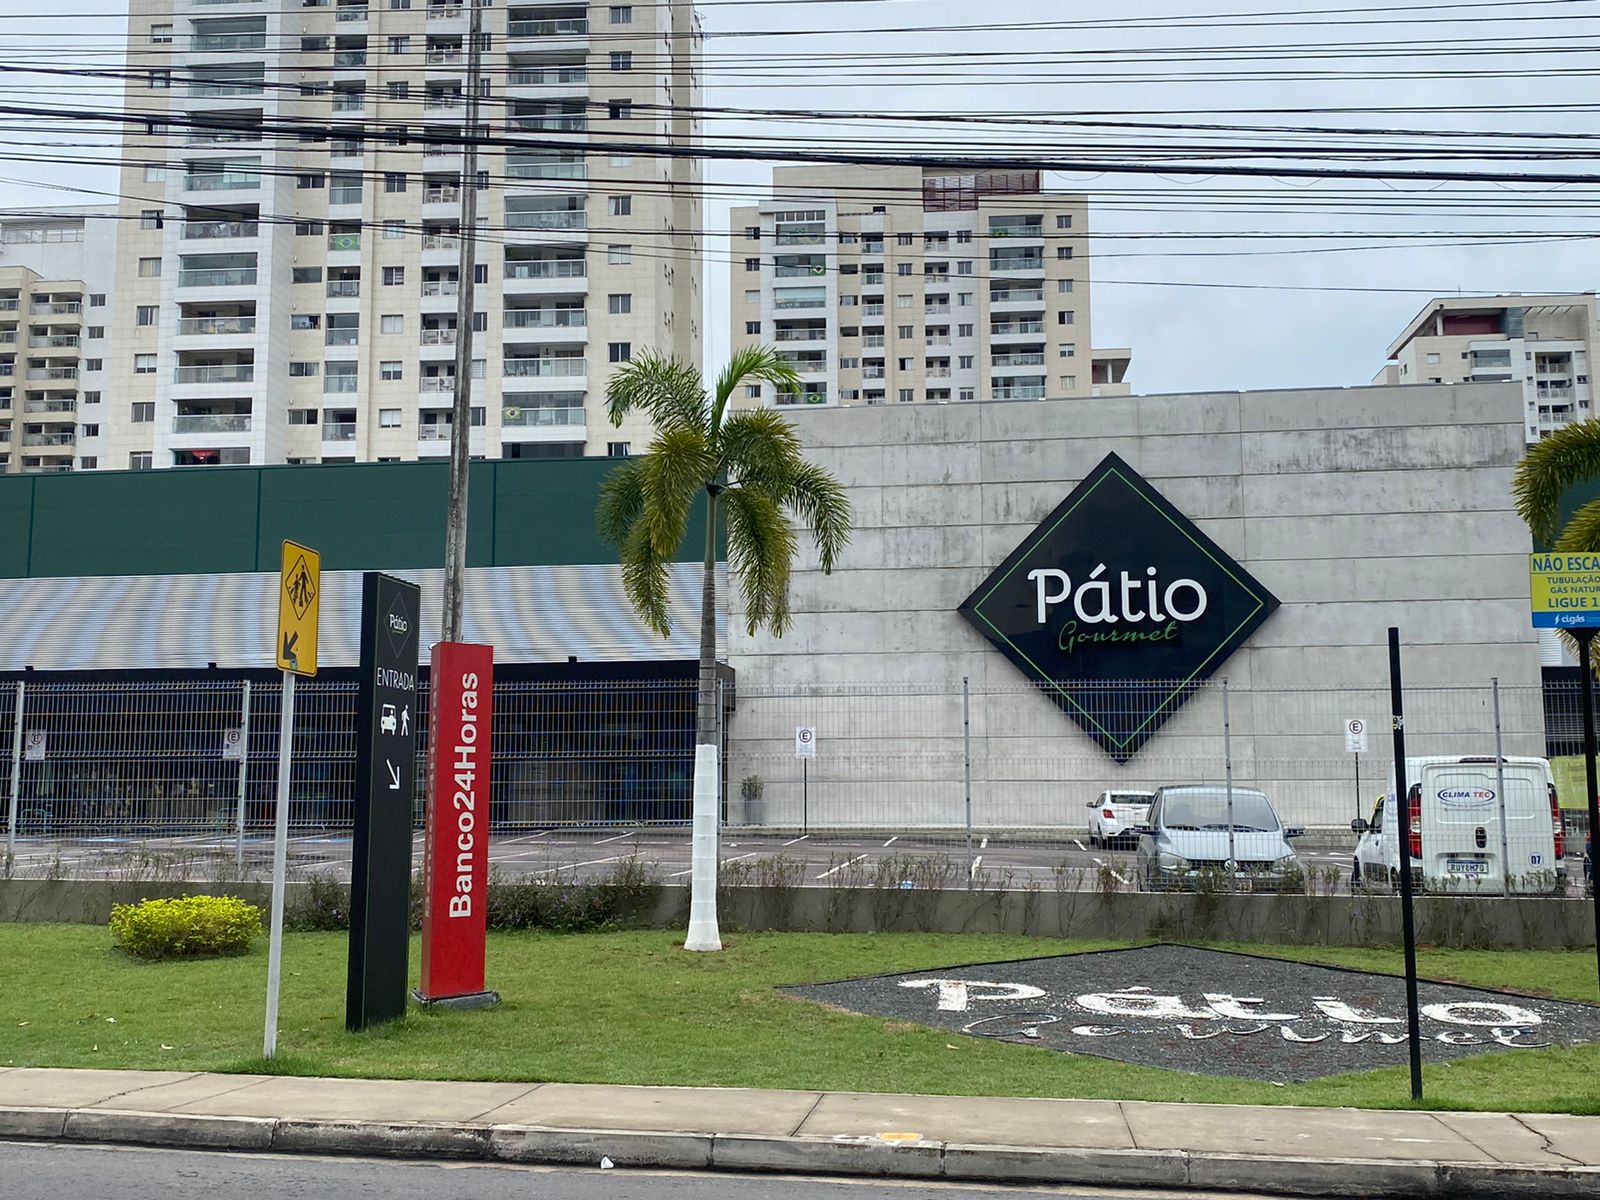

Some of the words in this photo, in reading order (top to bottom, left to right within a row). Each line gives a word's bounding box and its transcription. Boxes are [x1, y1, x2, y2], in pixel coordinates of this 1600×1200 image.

[1533, 554, 1563, 571] NÃO
[1567, 557, 1600, 571] ESCA
[1547, 575, 1600, 584] TUBULAÇÃO
[1027, 562, 1207, 624] Pátio
[1548, 597, 1587, 608] LIGUE
[389, 613, 408, 632] Pátio
[1058, 620, 1178, 654] Gourmet
[377, 667, 415, 692] ENTRADA
[449, 672, 479, 918] Banco24Horas
